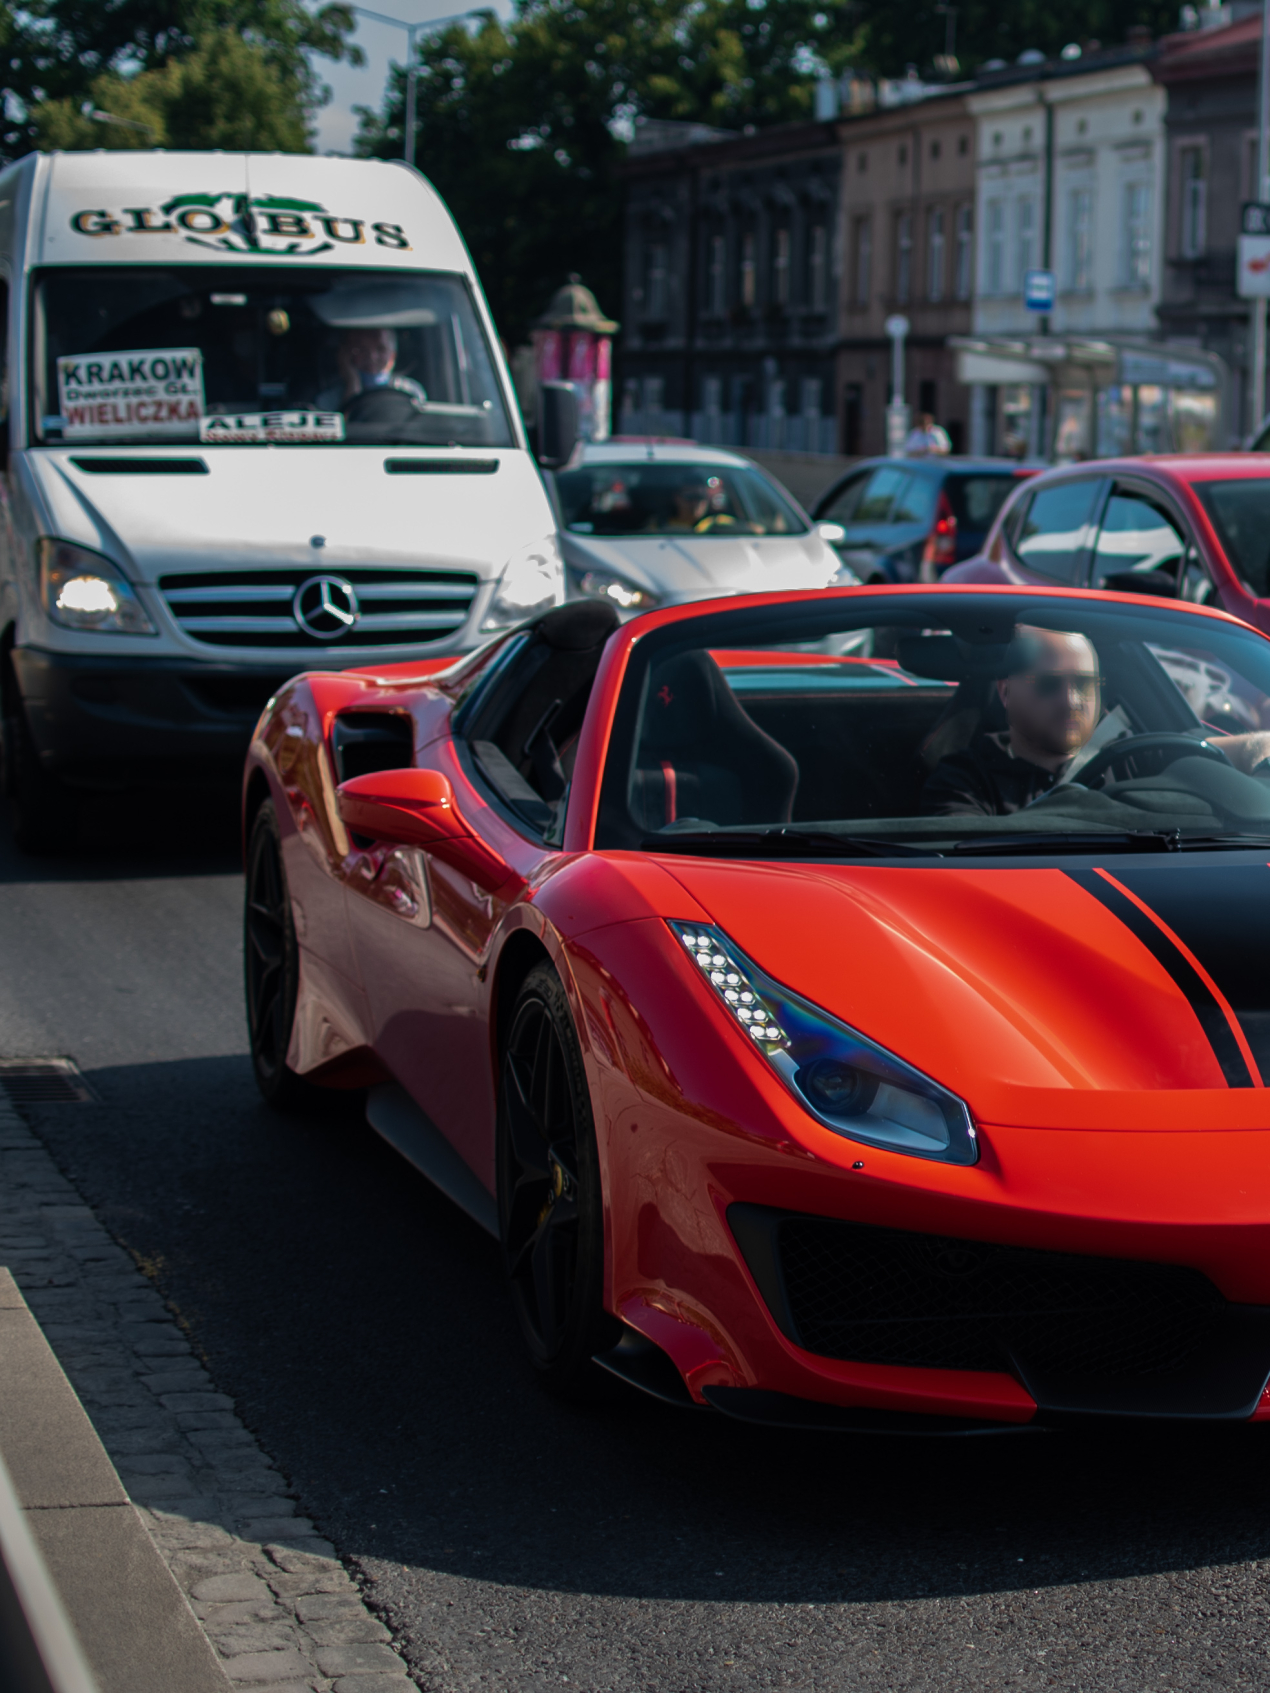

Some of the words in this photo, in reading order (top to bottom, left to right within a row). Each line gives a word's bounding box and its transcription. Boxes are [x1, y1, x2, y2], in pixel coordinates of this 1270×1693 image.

[70, 207, 413, 251] GLOBUS
[64, 358, 196, 386] KRAKOW
[65, 399, 200, 425] WIELICZKA
[205, 413, 340, 430] ALEJE
